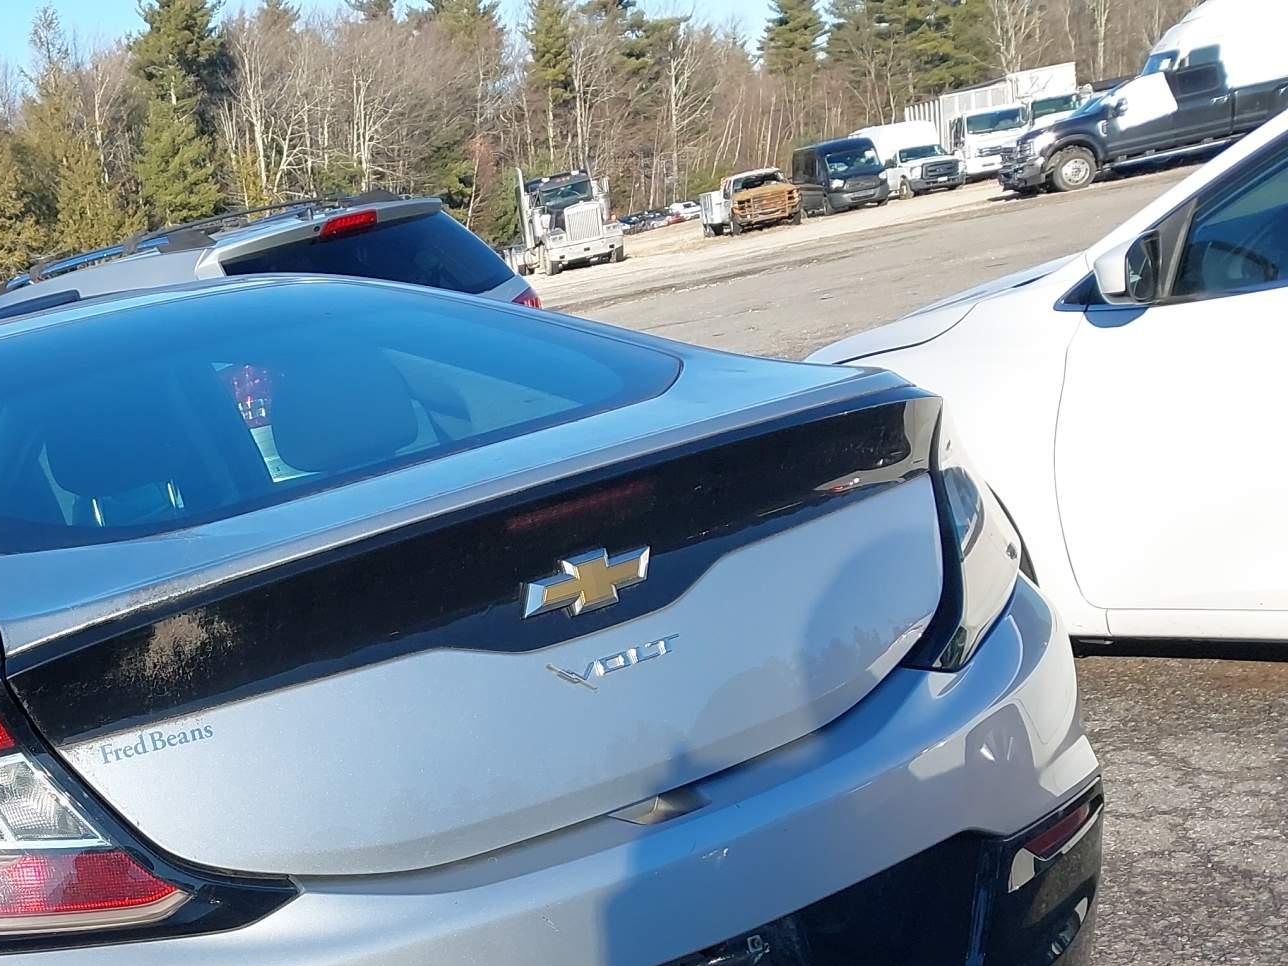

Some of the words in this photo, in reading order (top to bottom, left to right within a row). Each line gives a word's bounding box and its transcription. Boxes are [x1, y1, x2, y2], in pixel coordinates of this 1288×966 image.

[546, 633, 680, 690] VOLT
[100, 734, 149, 764] Fred
[149, 725, 213, 752] Beans
